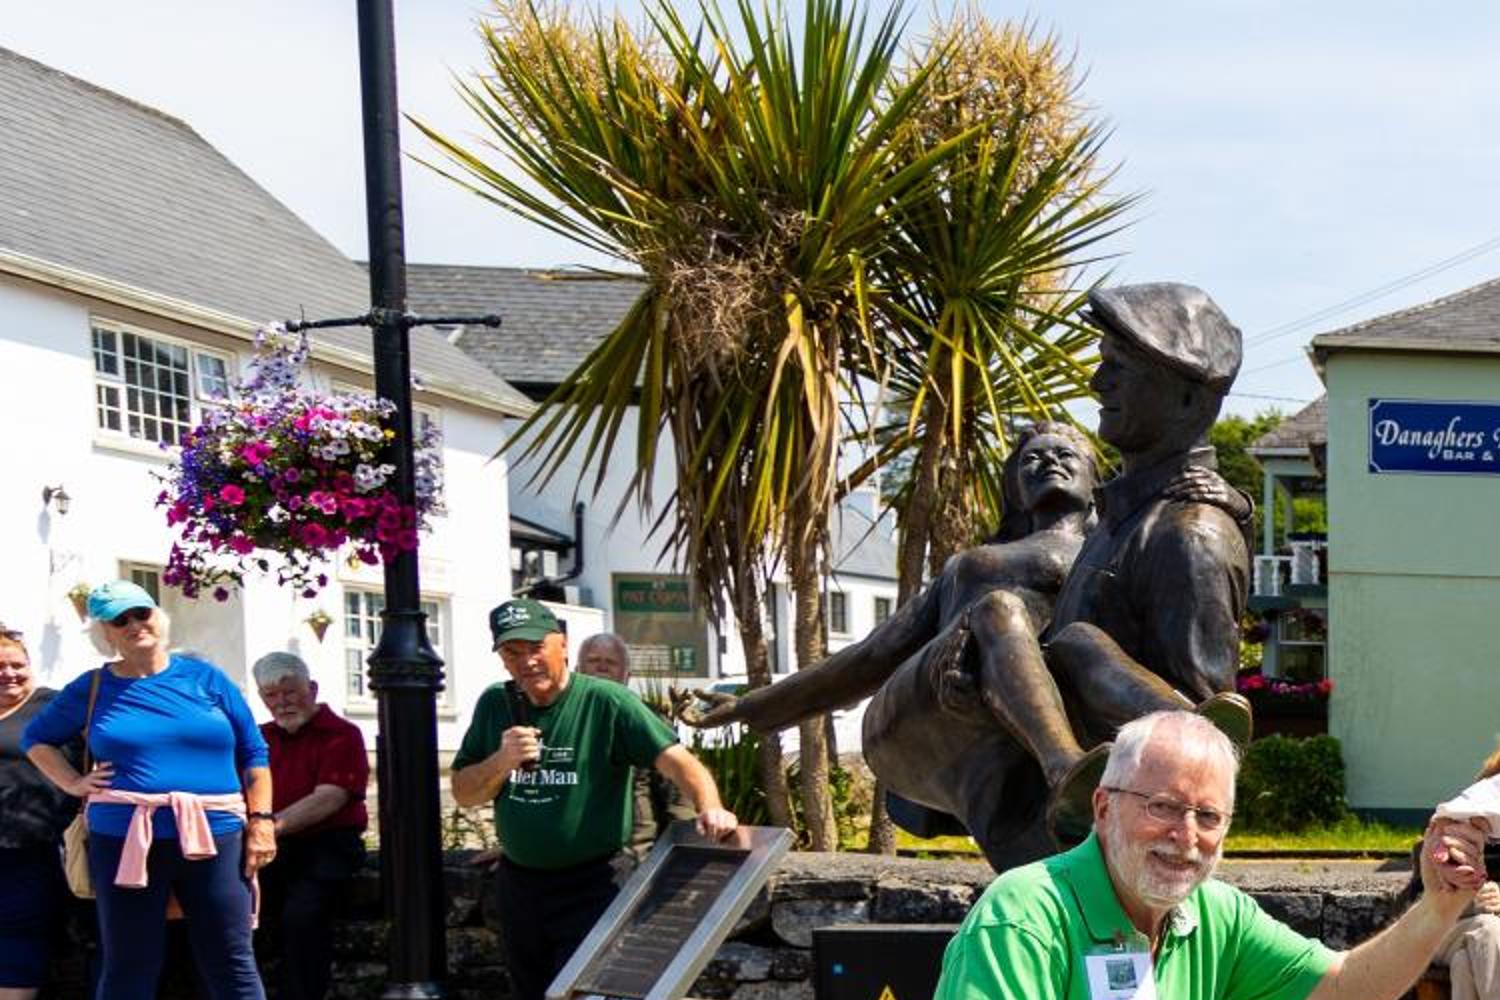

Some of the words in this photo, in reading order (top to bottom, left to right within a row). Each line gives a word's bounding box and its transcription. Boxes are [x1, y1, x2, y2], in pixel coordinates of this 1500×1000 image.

[1375, 416, 1485, 460] Danaghers
[1482, 451, 1494, 462] &
[540, 769, 579, 785] Man
